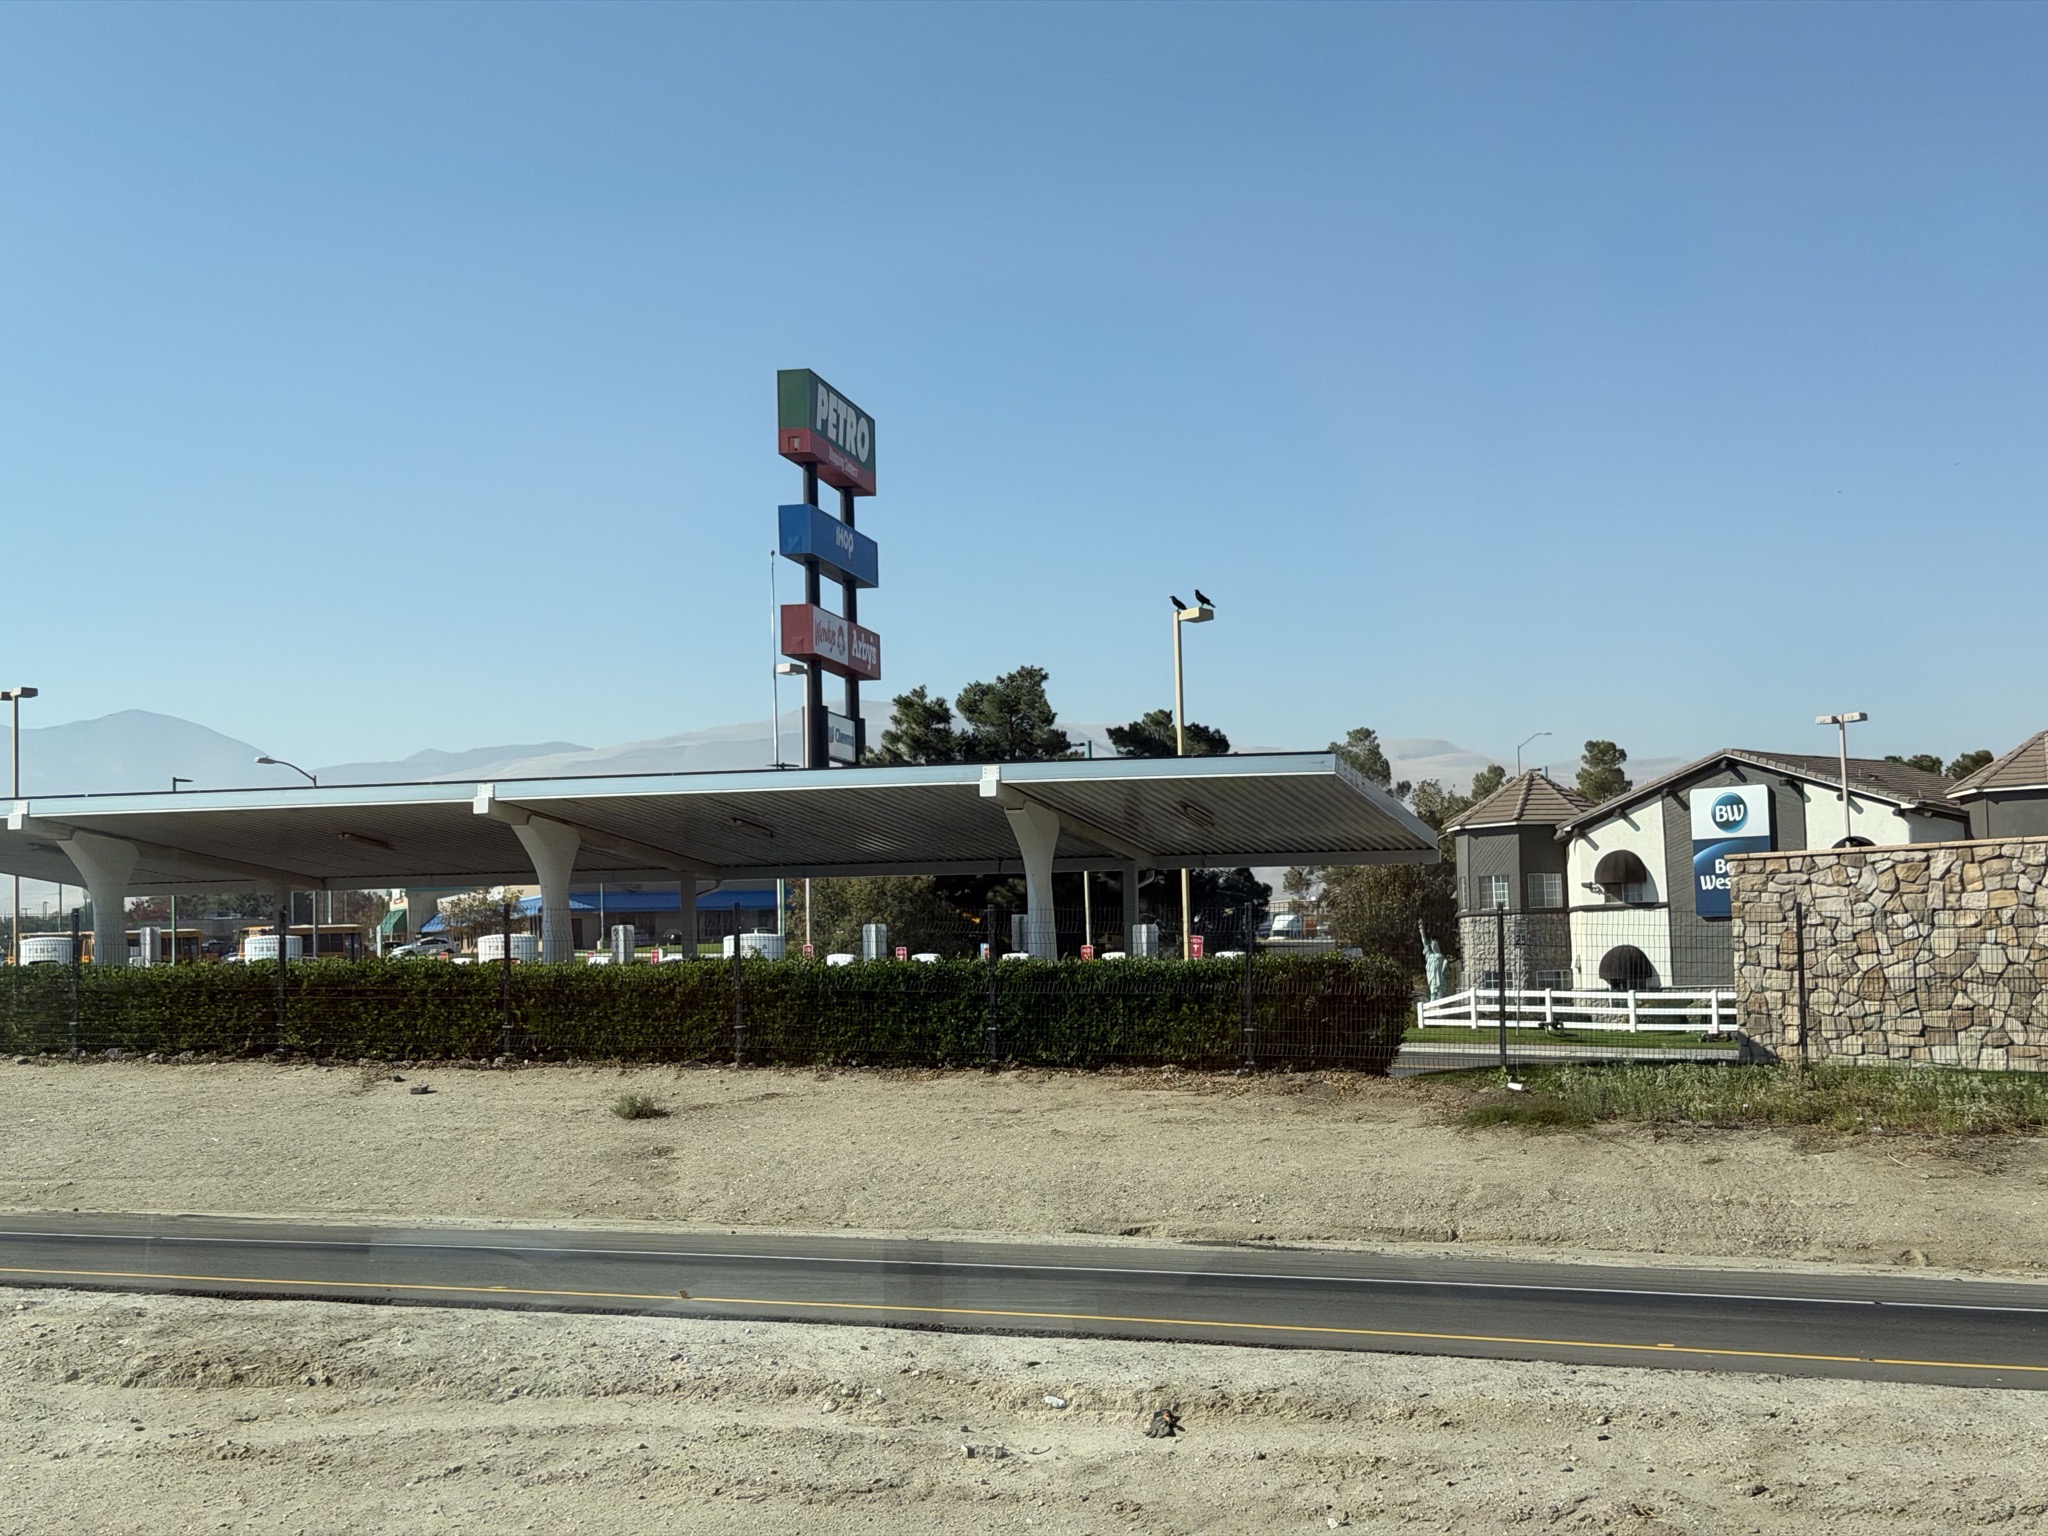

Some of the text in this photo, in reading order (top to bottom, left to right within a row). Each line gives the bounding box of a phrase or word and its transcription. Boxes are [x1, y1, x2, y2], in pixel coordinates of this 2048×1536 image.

[816, 382, 870, 463] PETRO
[852, 629, 877, 671] Arby's
[1715, 804, 1745, 822] BW
